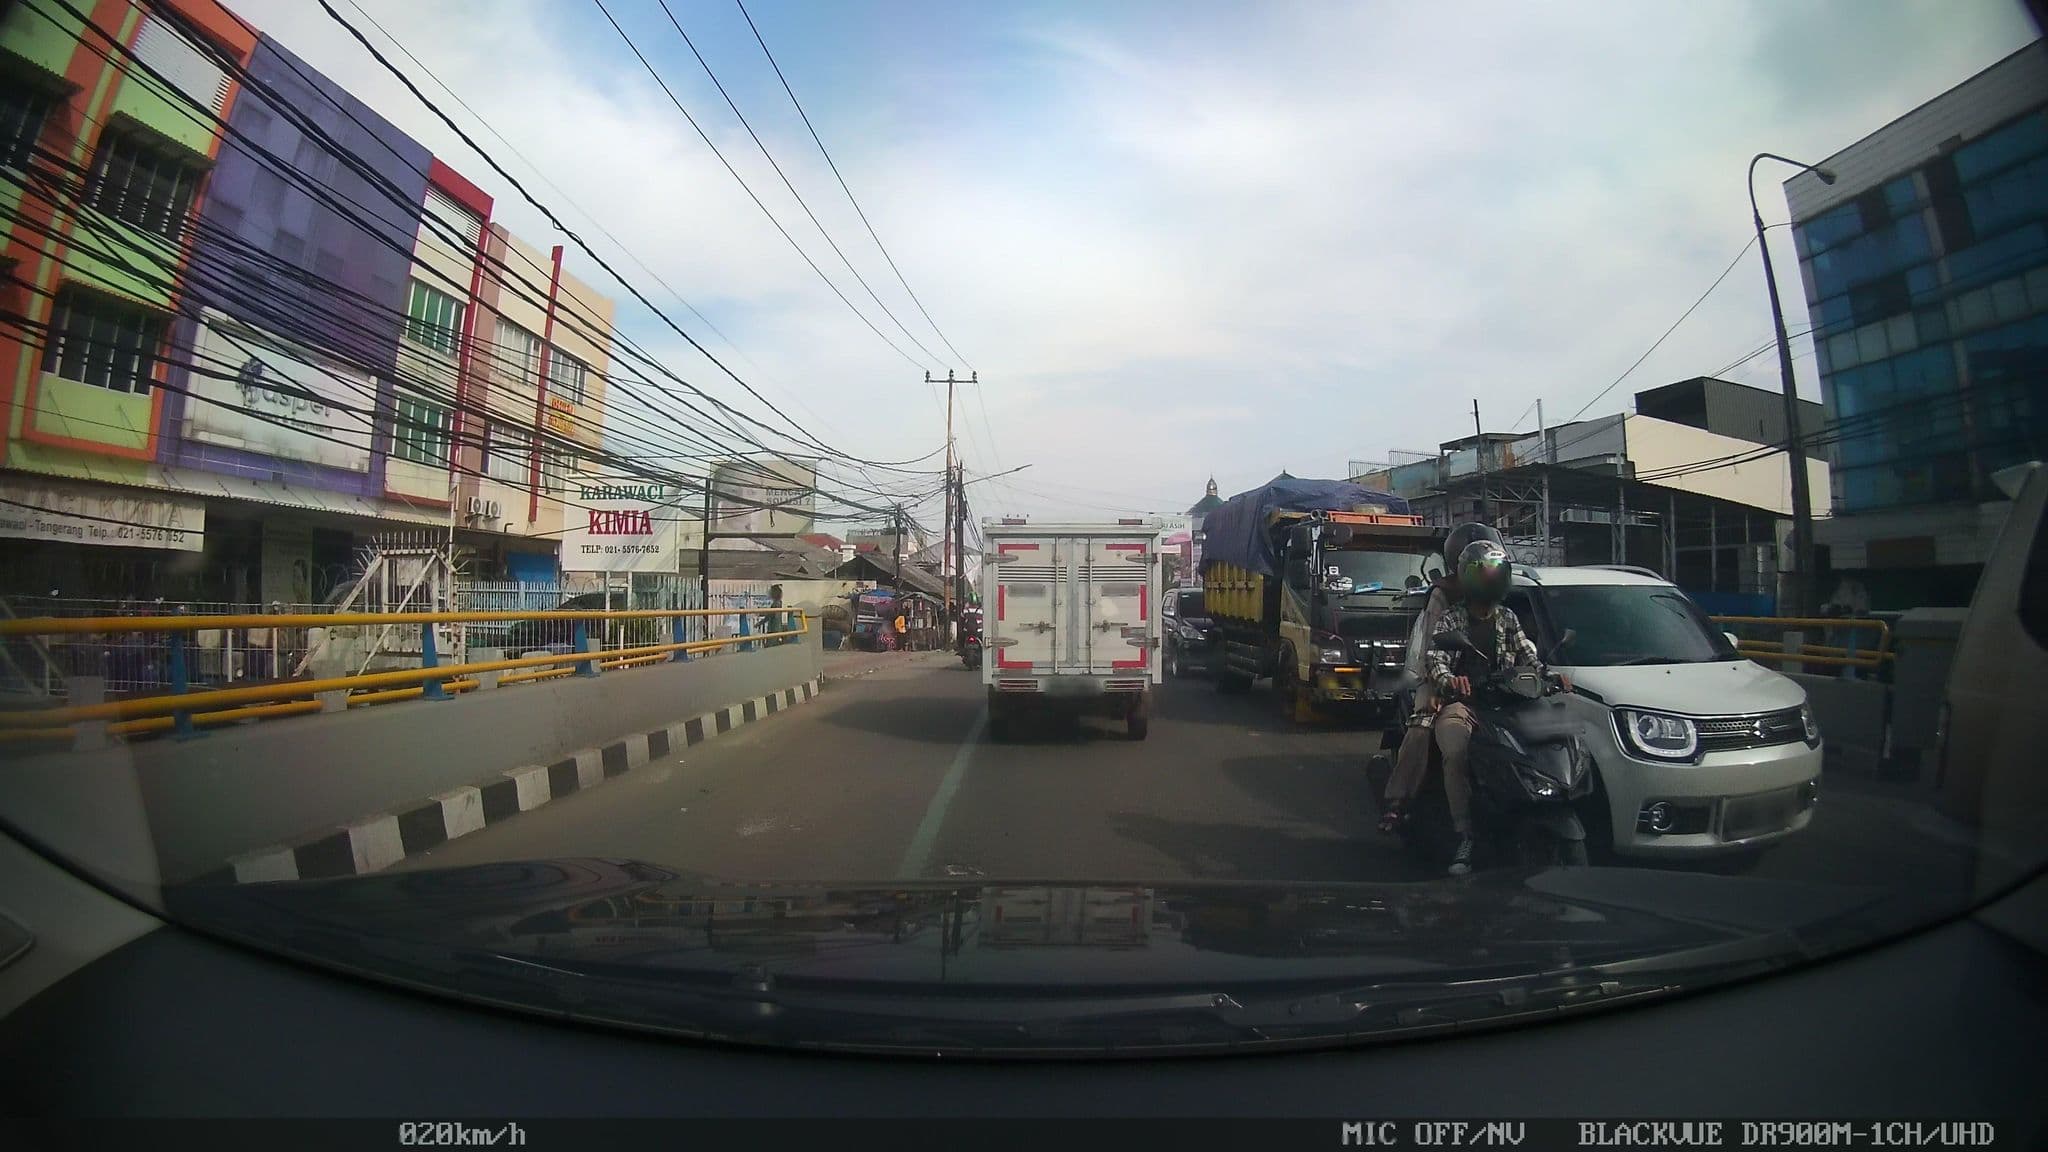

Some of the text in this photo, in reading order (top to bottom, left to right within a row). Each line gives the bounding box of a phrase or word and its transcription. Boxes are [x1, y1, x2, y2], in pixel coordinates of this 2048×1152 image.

[580, 484, 665, 500] KARAWACI
[588, 510, 653, 535] KIMIA
[581, 544, 603, 554] TELP:
